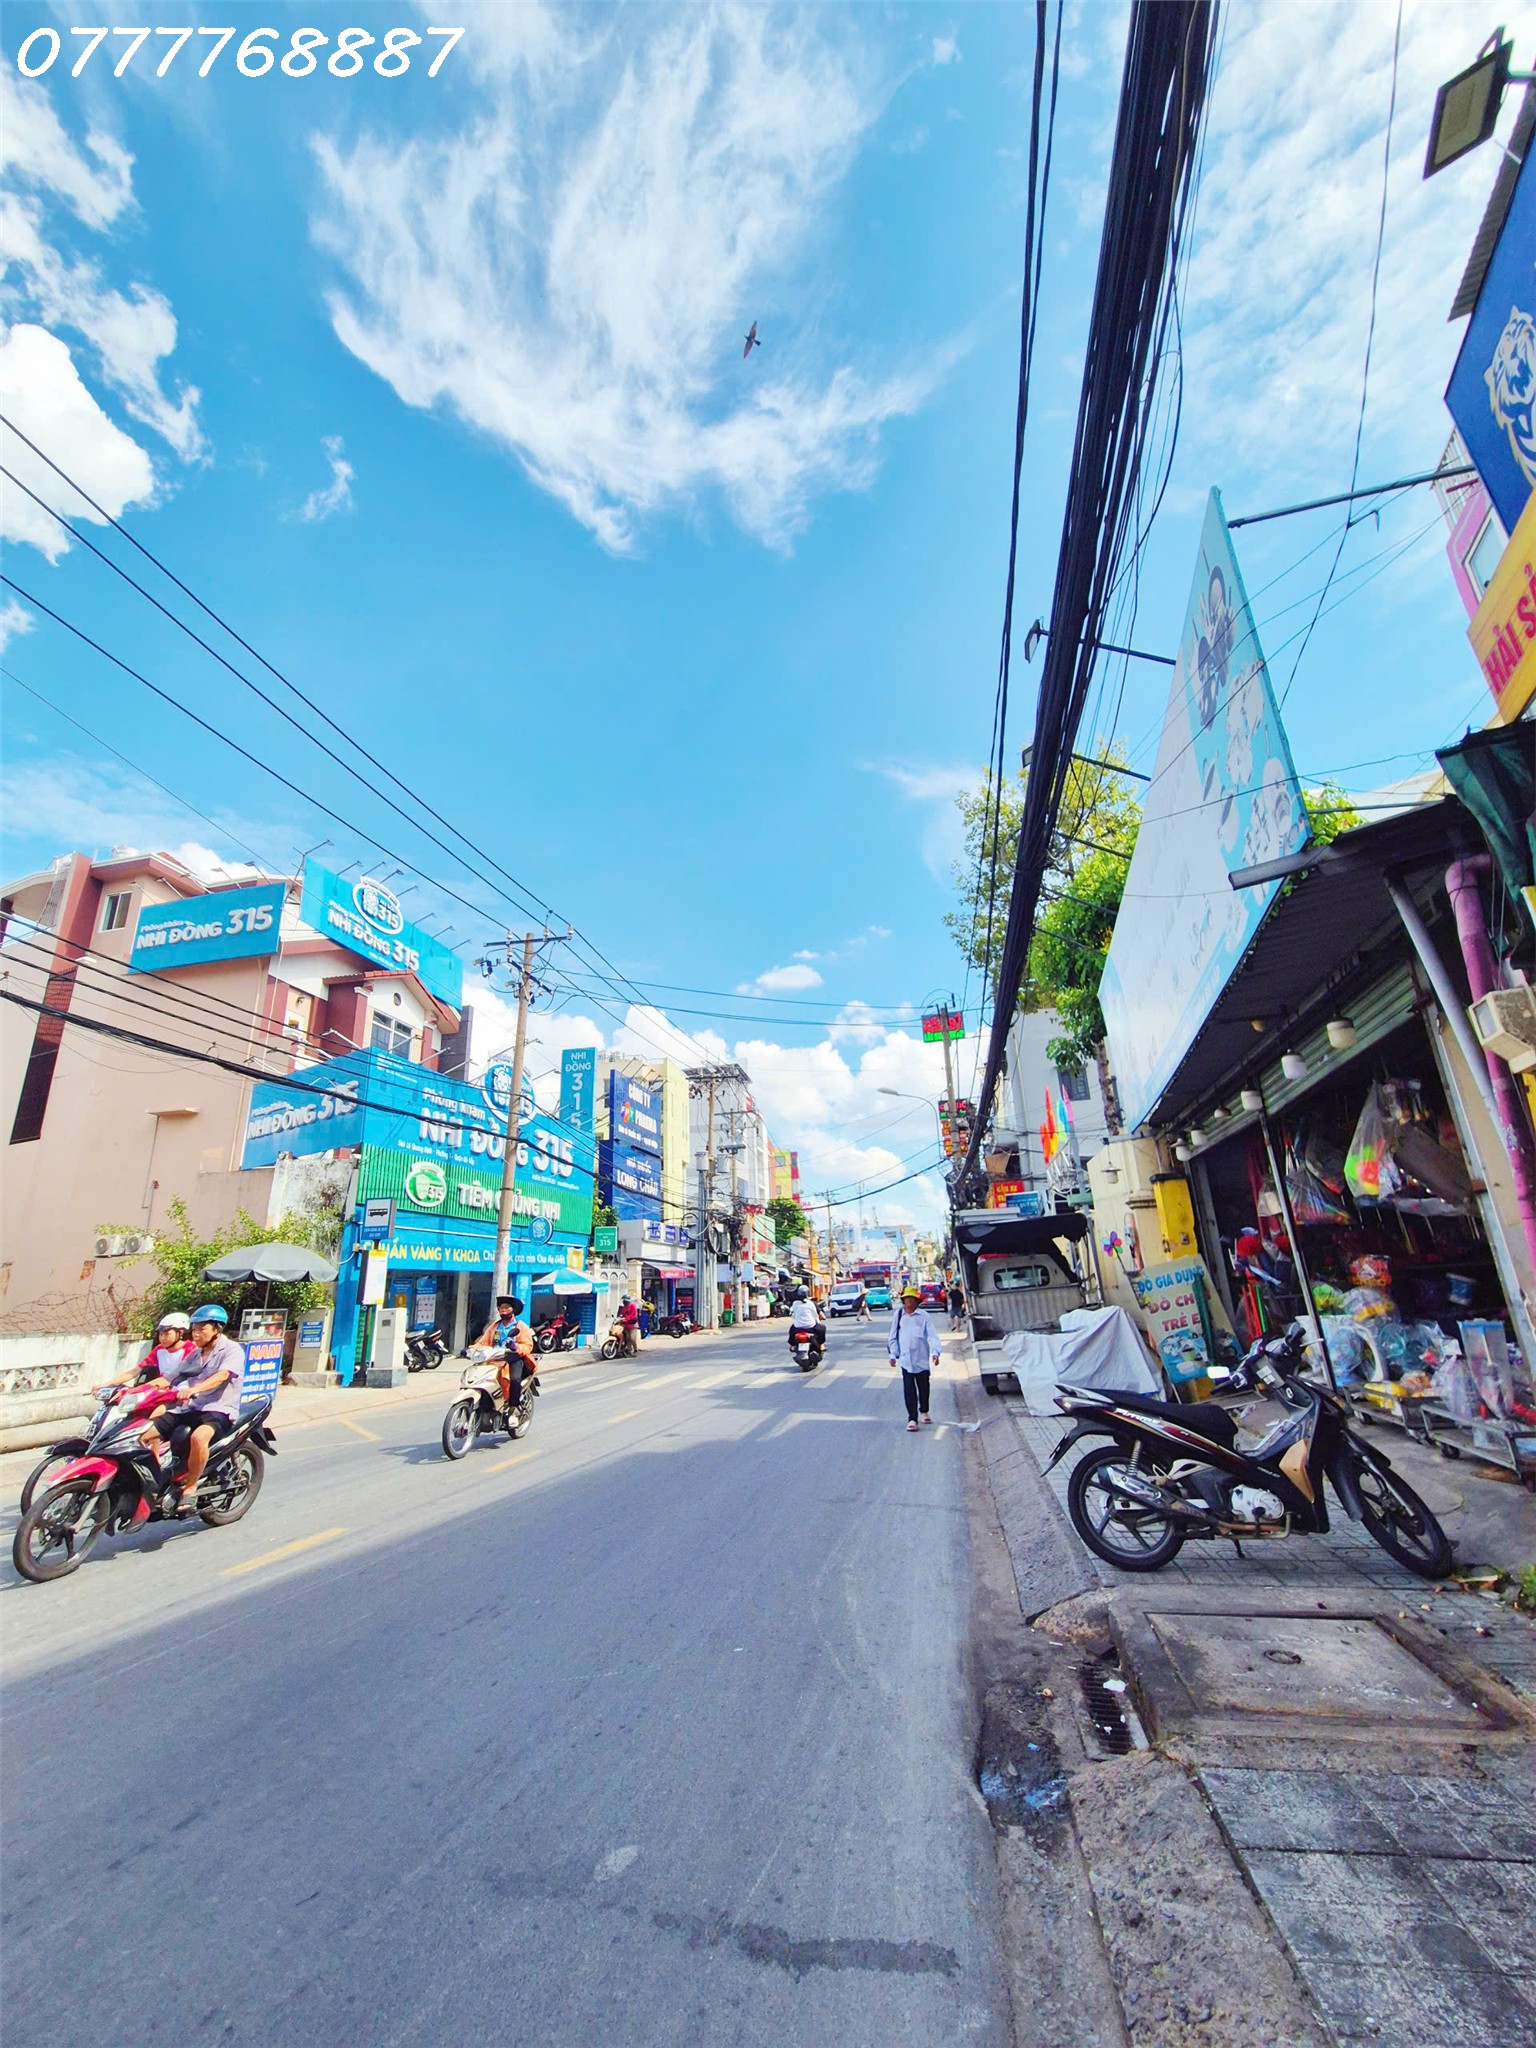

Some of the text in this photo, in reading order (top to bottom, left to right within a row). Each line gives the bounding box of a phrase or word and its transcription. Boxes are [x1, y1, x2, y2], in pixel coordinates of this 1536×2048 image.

[1485, 621, 1524, 695] HẢI
[136, 904, 273, 949] NHI ĐỒNG 315
[378, 904, 399, 929] 315
[328, 908, 351, 933] NHI
[353, 924, 390, 956] ĐỒNG
[392, 939, 420, 971] 315
[565, 1060, 591, 1072] ĐỒNG
[571, 1052, 586, 1061] NHI
[423, 1087, 457, 1112] Phòng
[248, 1116, 272, 1140] NHI
[419, 1107, 463, 1147] NHI
[470, 1117, 528, 1166] ĐỒG
[532, 1129, 574, 1177] 315
[617, 1169, 637, 1191] LONG
[458, 1180, 561, 1221] TIÊM CỦNG NHI
[410, 1242, 442, 1260] VÀNG
[444, 1247, 452, 1261] Y
[453, 1248, 480, 1263] KHOA
[599, 1239, 612, 1247] 315
[1137, 1274, 1153, 1293] ĐỒ
[1156, 1273, 1174, 1289] GIA
[1148, 1296, 1171, 1315] ĐỒ
[1162, 1312, 1201, 1332] TRẺ E
[248, 1343, 282, 1360] NAM
